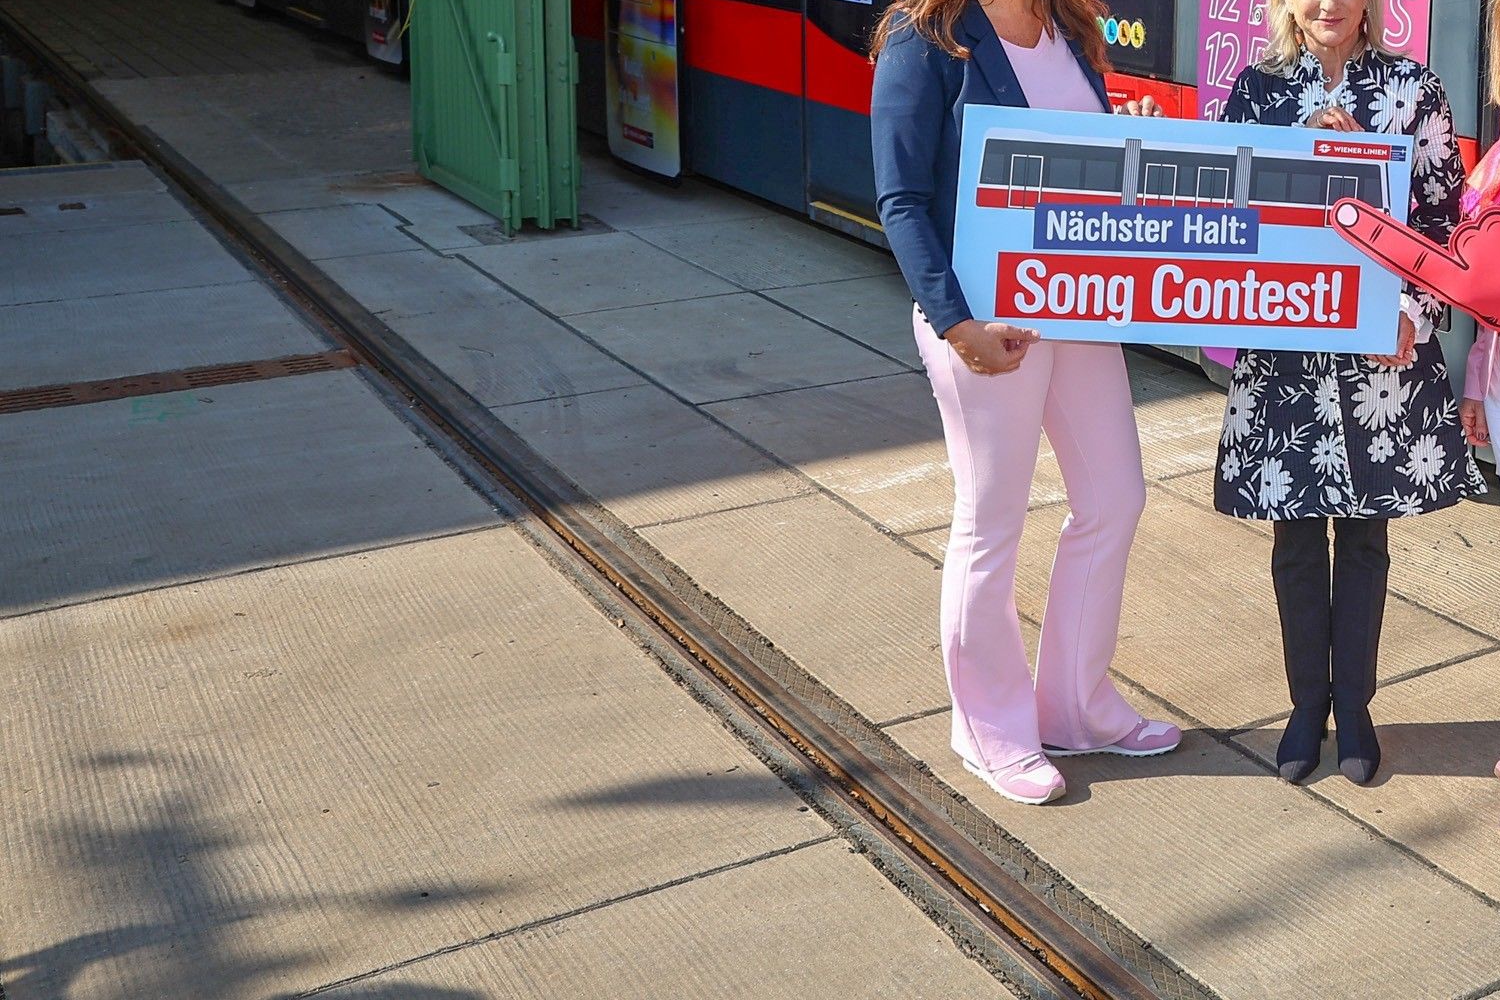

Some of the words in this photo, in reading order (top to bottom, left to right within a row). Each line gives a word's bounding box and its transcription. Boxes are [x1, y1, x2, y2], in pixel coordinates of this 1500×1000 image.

[1205, 31, 1241, 90] 12
[1333, 146, 1362, 155] WIENER
[1363, 147, 1388, 156] LINIEN
[1046, 209, 1173, 244] Nächster
[1183, 213, 1248, 246] Halt:
[1014, 258, 1135, 328] Song
[1151, 263, 1343, 323] Contest!
